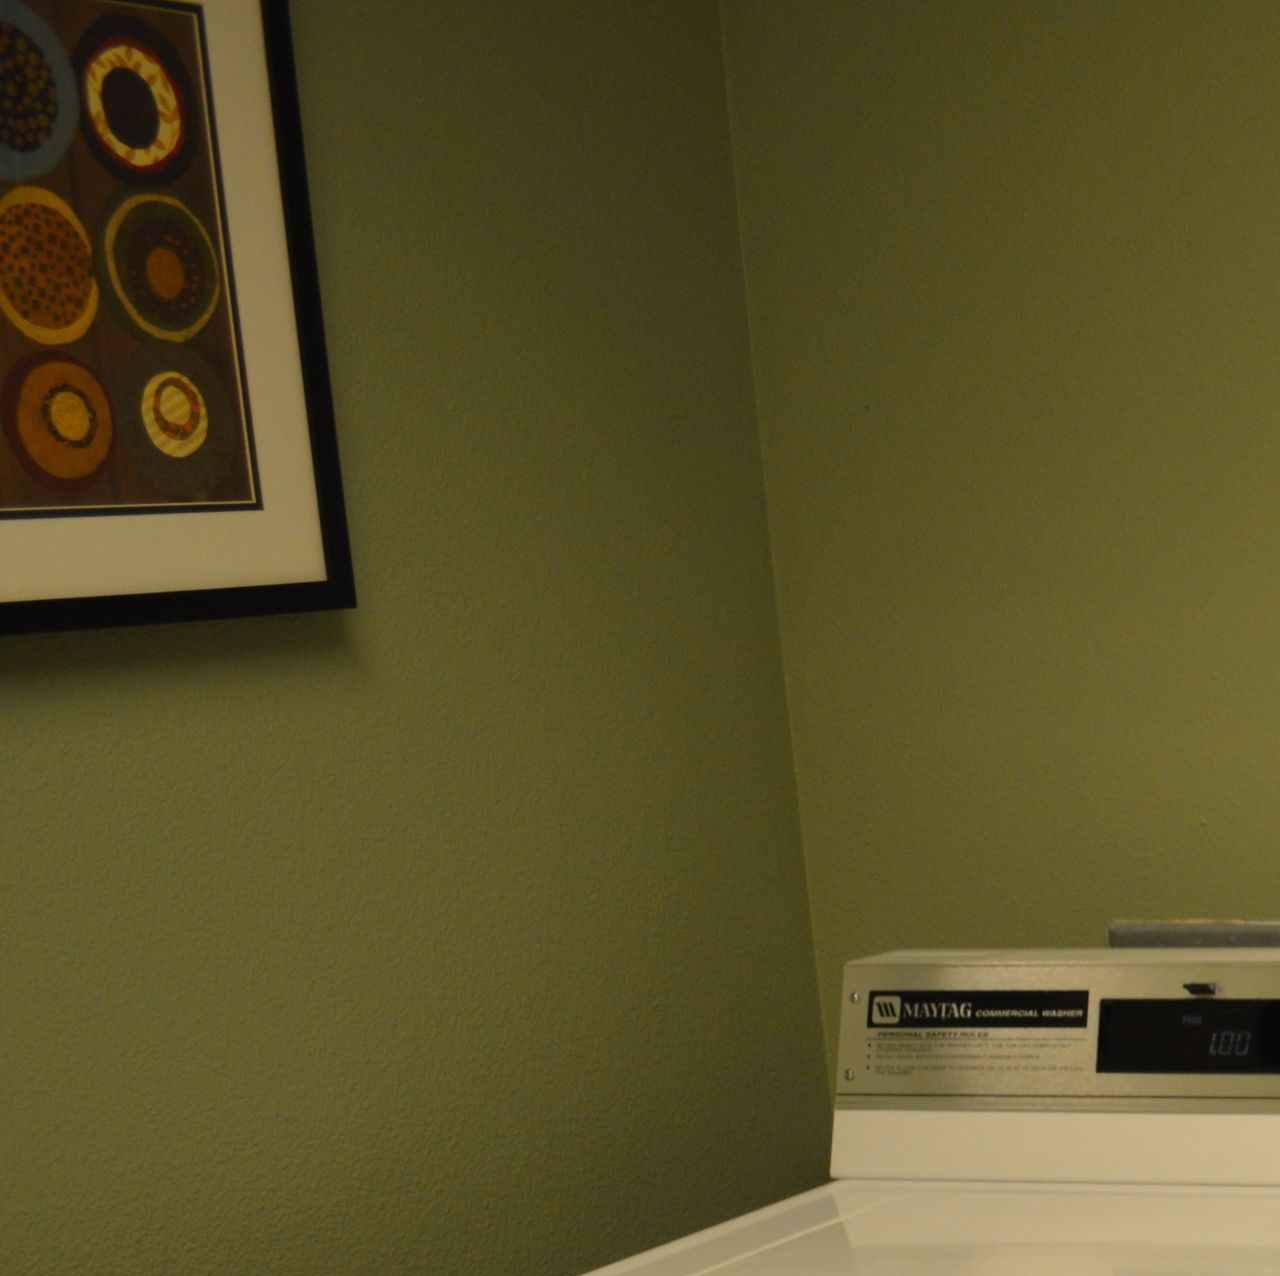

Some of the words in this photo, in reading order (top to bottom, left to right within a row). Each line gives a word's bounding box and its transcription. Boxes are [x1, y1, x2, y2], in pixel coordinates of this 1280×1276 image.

[903, 1001, 972, 1019] MAYTAG
[975, 1009, 1038, 1018] COMMERCIAL
[1041, 1009, 1084, 1018] WASHER
